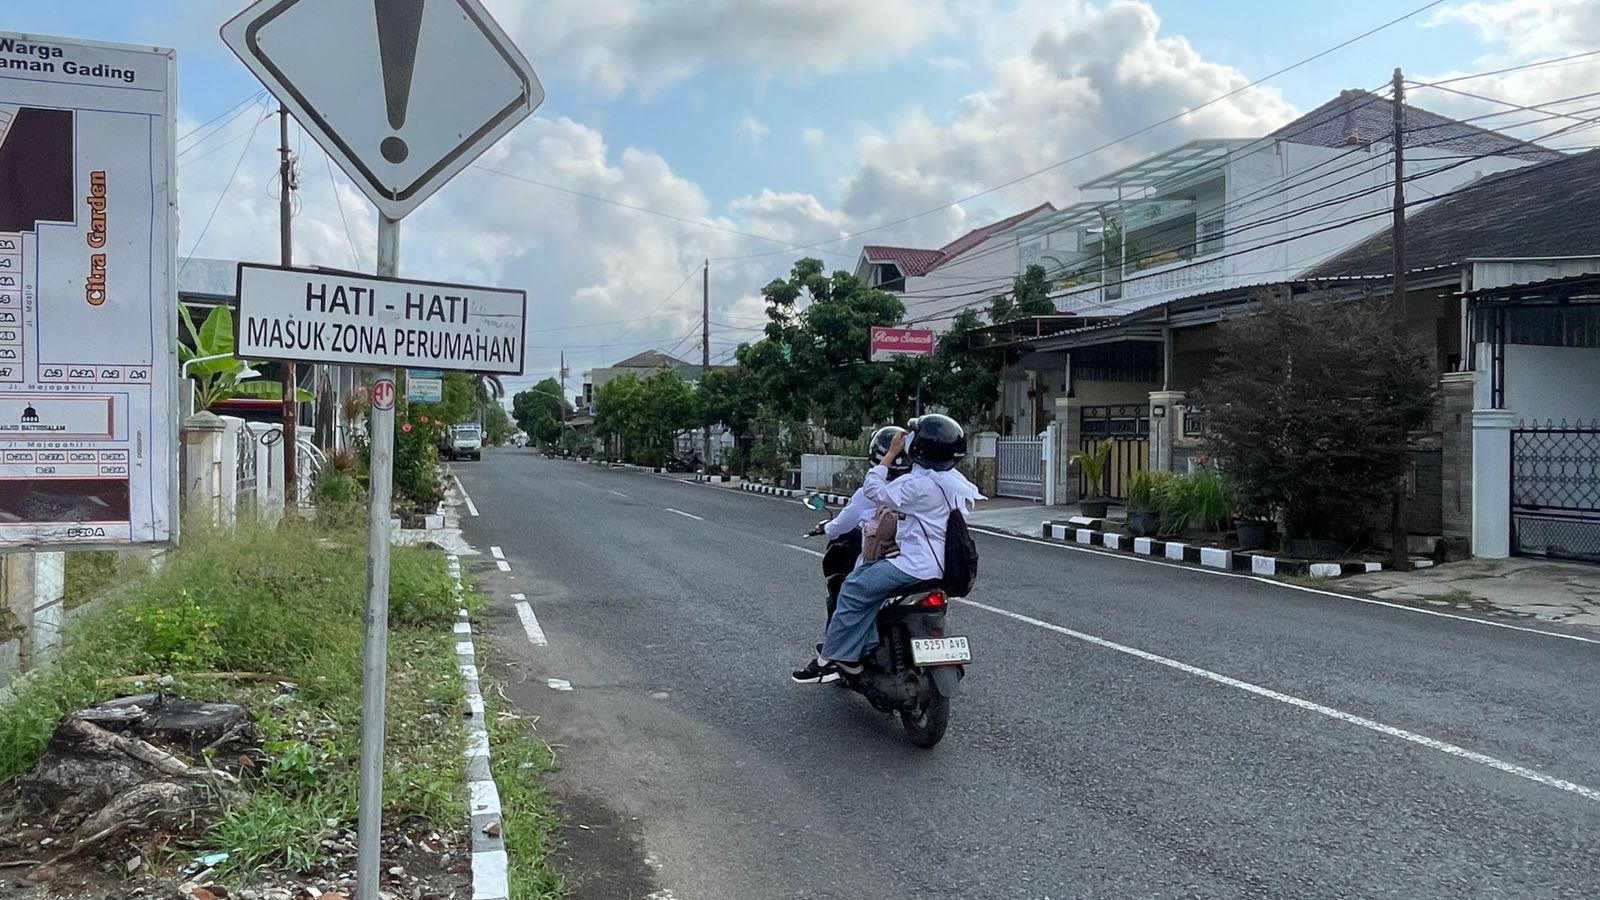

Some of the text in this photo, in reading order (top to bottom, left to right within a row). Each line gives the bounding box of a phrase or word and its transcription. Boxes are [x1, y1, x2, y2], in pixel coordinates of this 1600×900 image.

[62, 61, 135, 83] Gading
[85, 171, 106, 306] Citra Garden
[305, 282, 375, 317] HATI
[404, 292, 469, 325] HATI
[247, 316, 516, 364] MASUK ZONA PERUMAHAN
[44, 368, 63, 378] A-3
[69, 369, 95, 379] A-2A
[101, 370, 120, 379] A-2
[130, 370, 147, 379] A-1
[914, 638, 966, 650] R 5251 AVB
